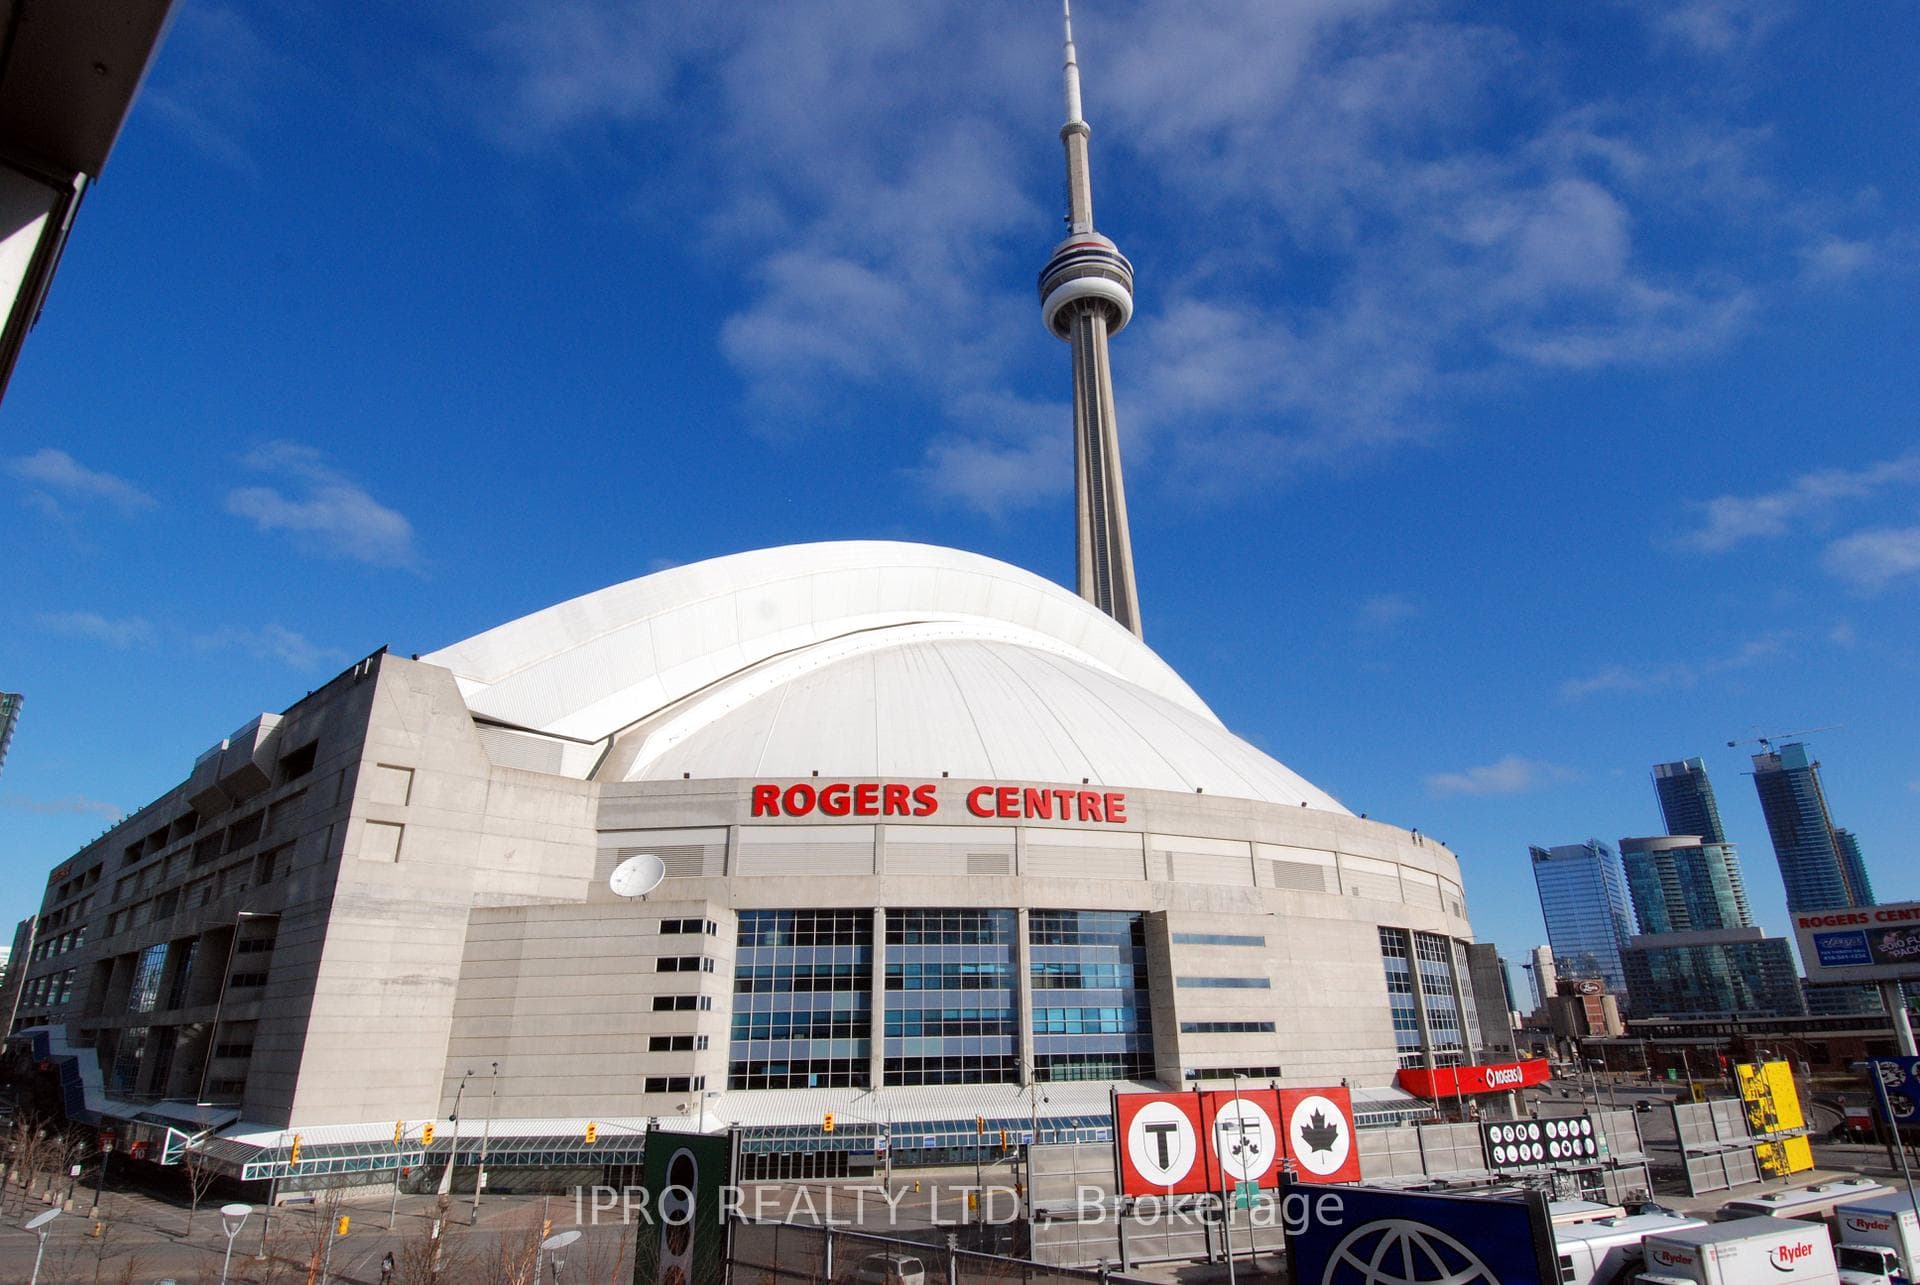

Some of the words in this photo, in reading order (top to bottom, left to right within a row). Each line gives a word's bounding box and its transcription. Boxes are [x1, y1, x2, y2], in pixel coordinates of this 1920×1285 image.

[752, 783, 938, 817] ROGERS
[967, 785, 1127, 823] CENTRE
[1799, 913, 1868, 928] ROGERS
[1875, 908, 1920, 921] CENT
[1495, 1068, 1518, 1084] ROGERS
[1144, 1123, 1178, 1170] T
[1856, 1218, 1889, 1231] Ryder
[1662, 1250, 1693, 1265] Ryder
[1778, 1242, 1813, 1264] Ryder
